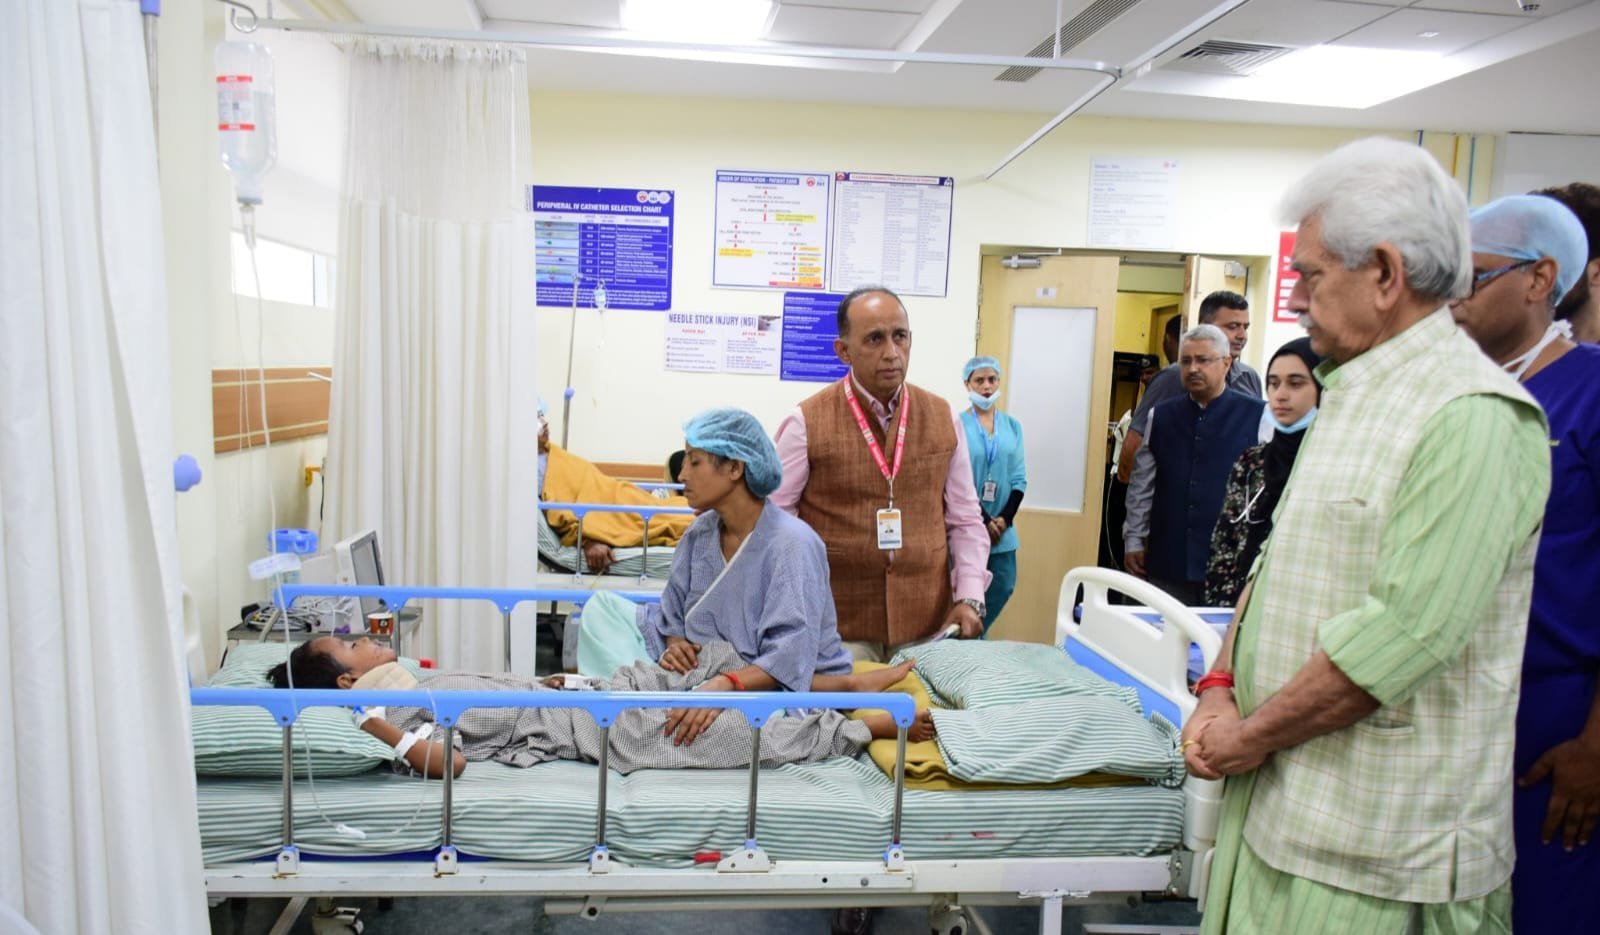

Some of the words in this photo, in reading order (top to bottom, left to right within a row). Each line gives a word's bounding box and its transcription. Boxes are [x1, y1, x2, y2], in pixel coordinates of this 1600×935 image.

[537, 201, 572, 210] PERIPHERAL
[580, 203, 610, 211] CATHETER
[611, 204, 642, 212] SELECTION
[669, 313, 693, 324] NEEDLE
[695, 315, 713, 325] STICK
[715, 315, 738, 326] INJURY
[741, 316, 757, 328] (NSI)
